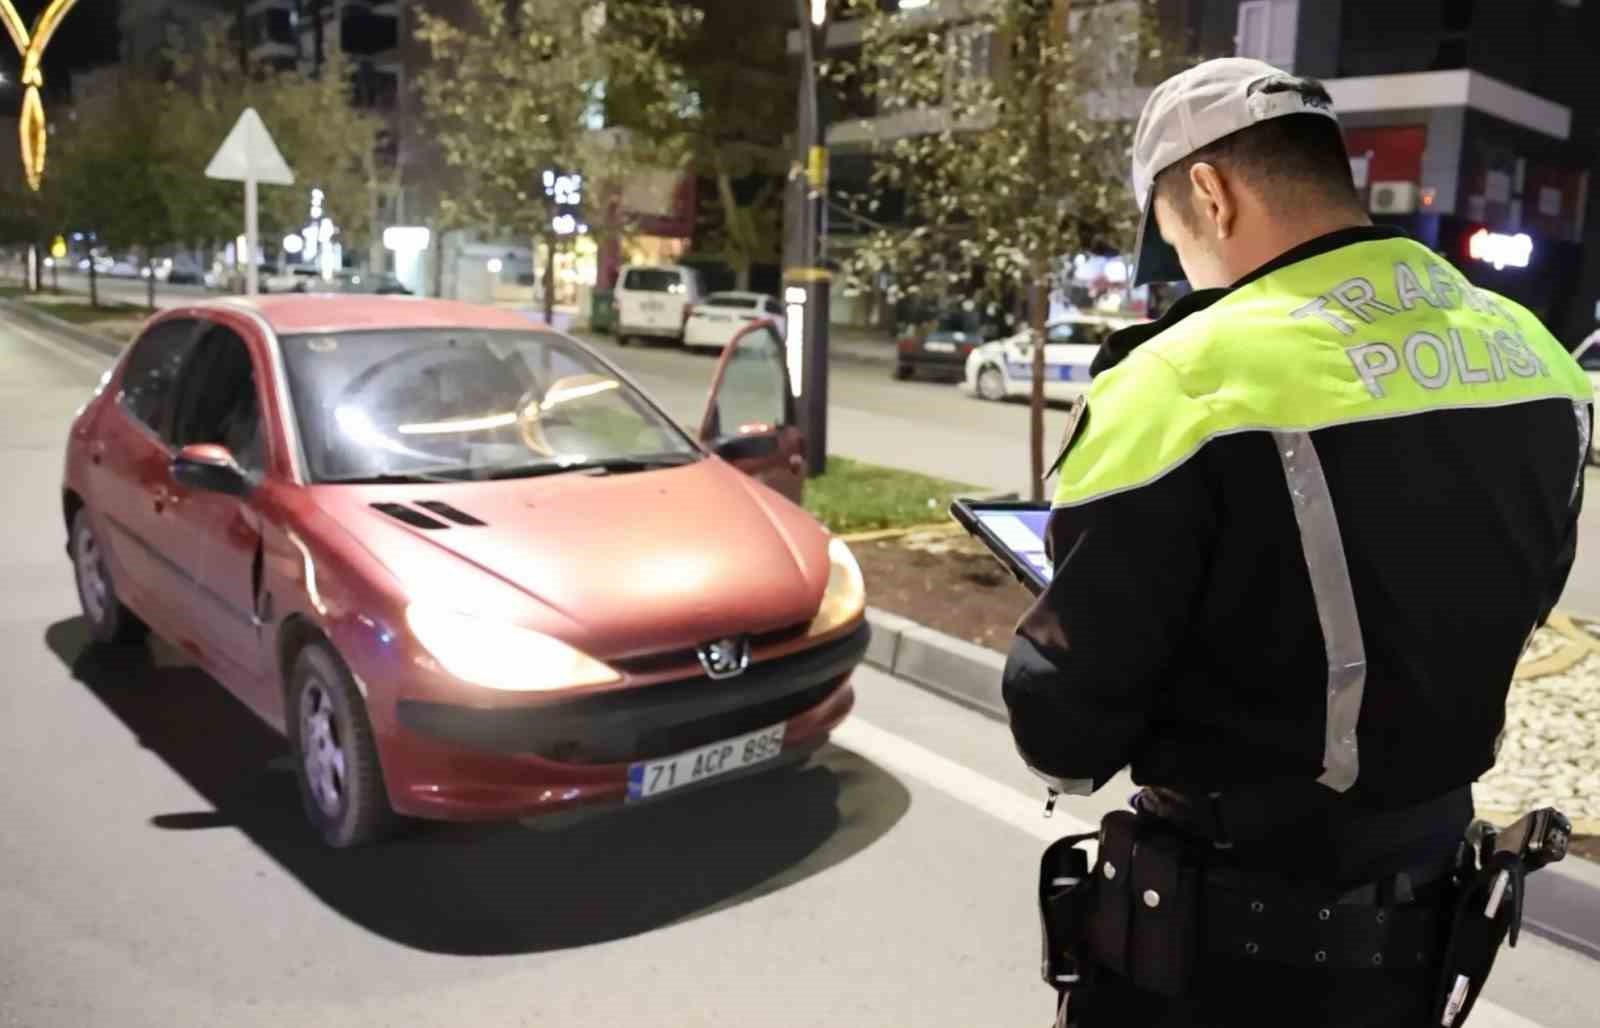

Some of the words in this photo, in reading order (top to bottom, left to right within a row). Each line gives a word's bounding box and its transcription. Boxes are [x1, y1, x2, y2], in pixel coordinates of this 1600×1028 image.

[650, 763, 676, 792] 71
[692, 745, 734, 777] ACP
[742, 728, 782, 763] 895
